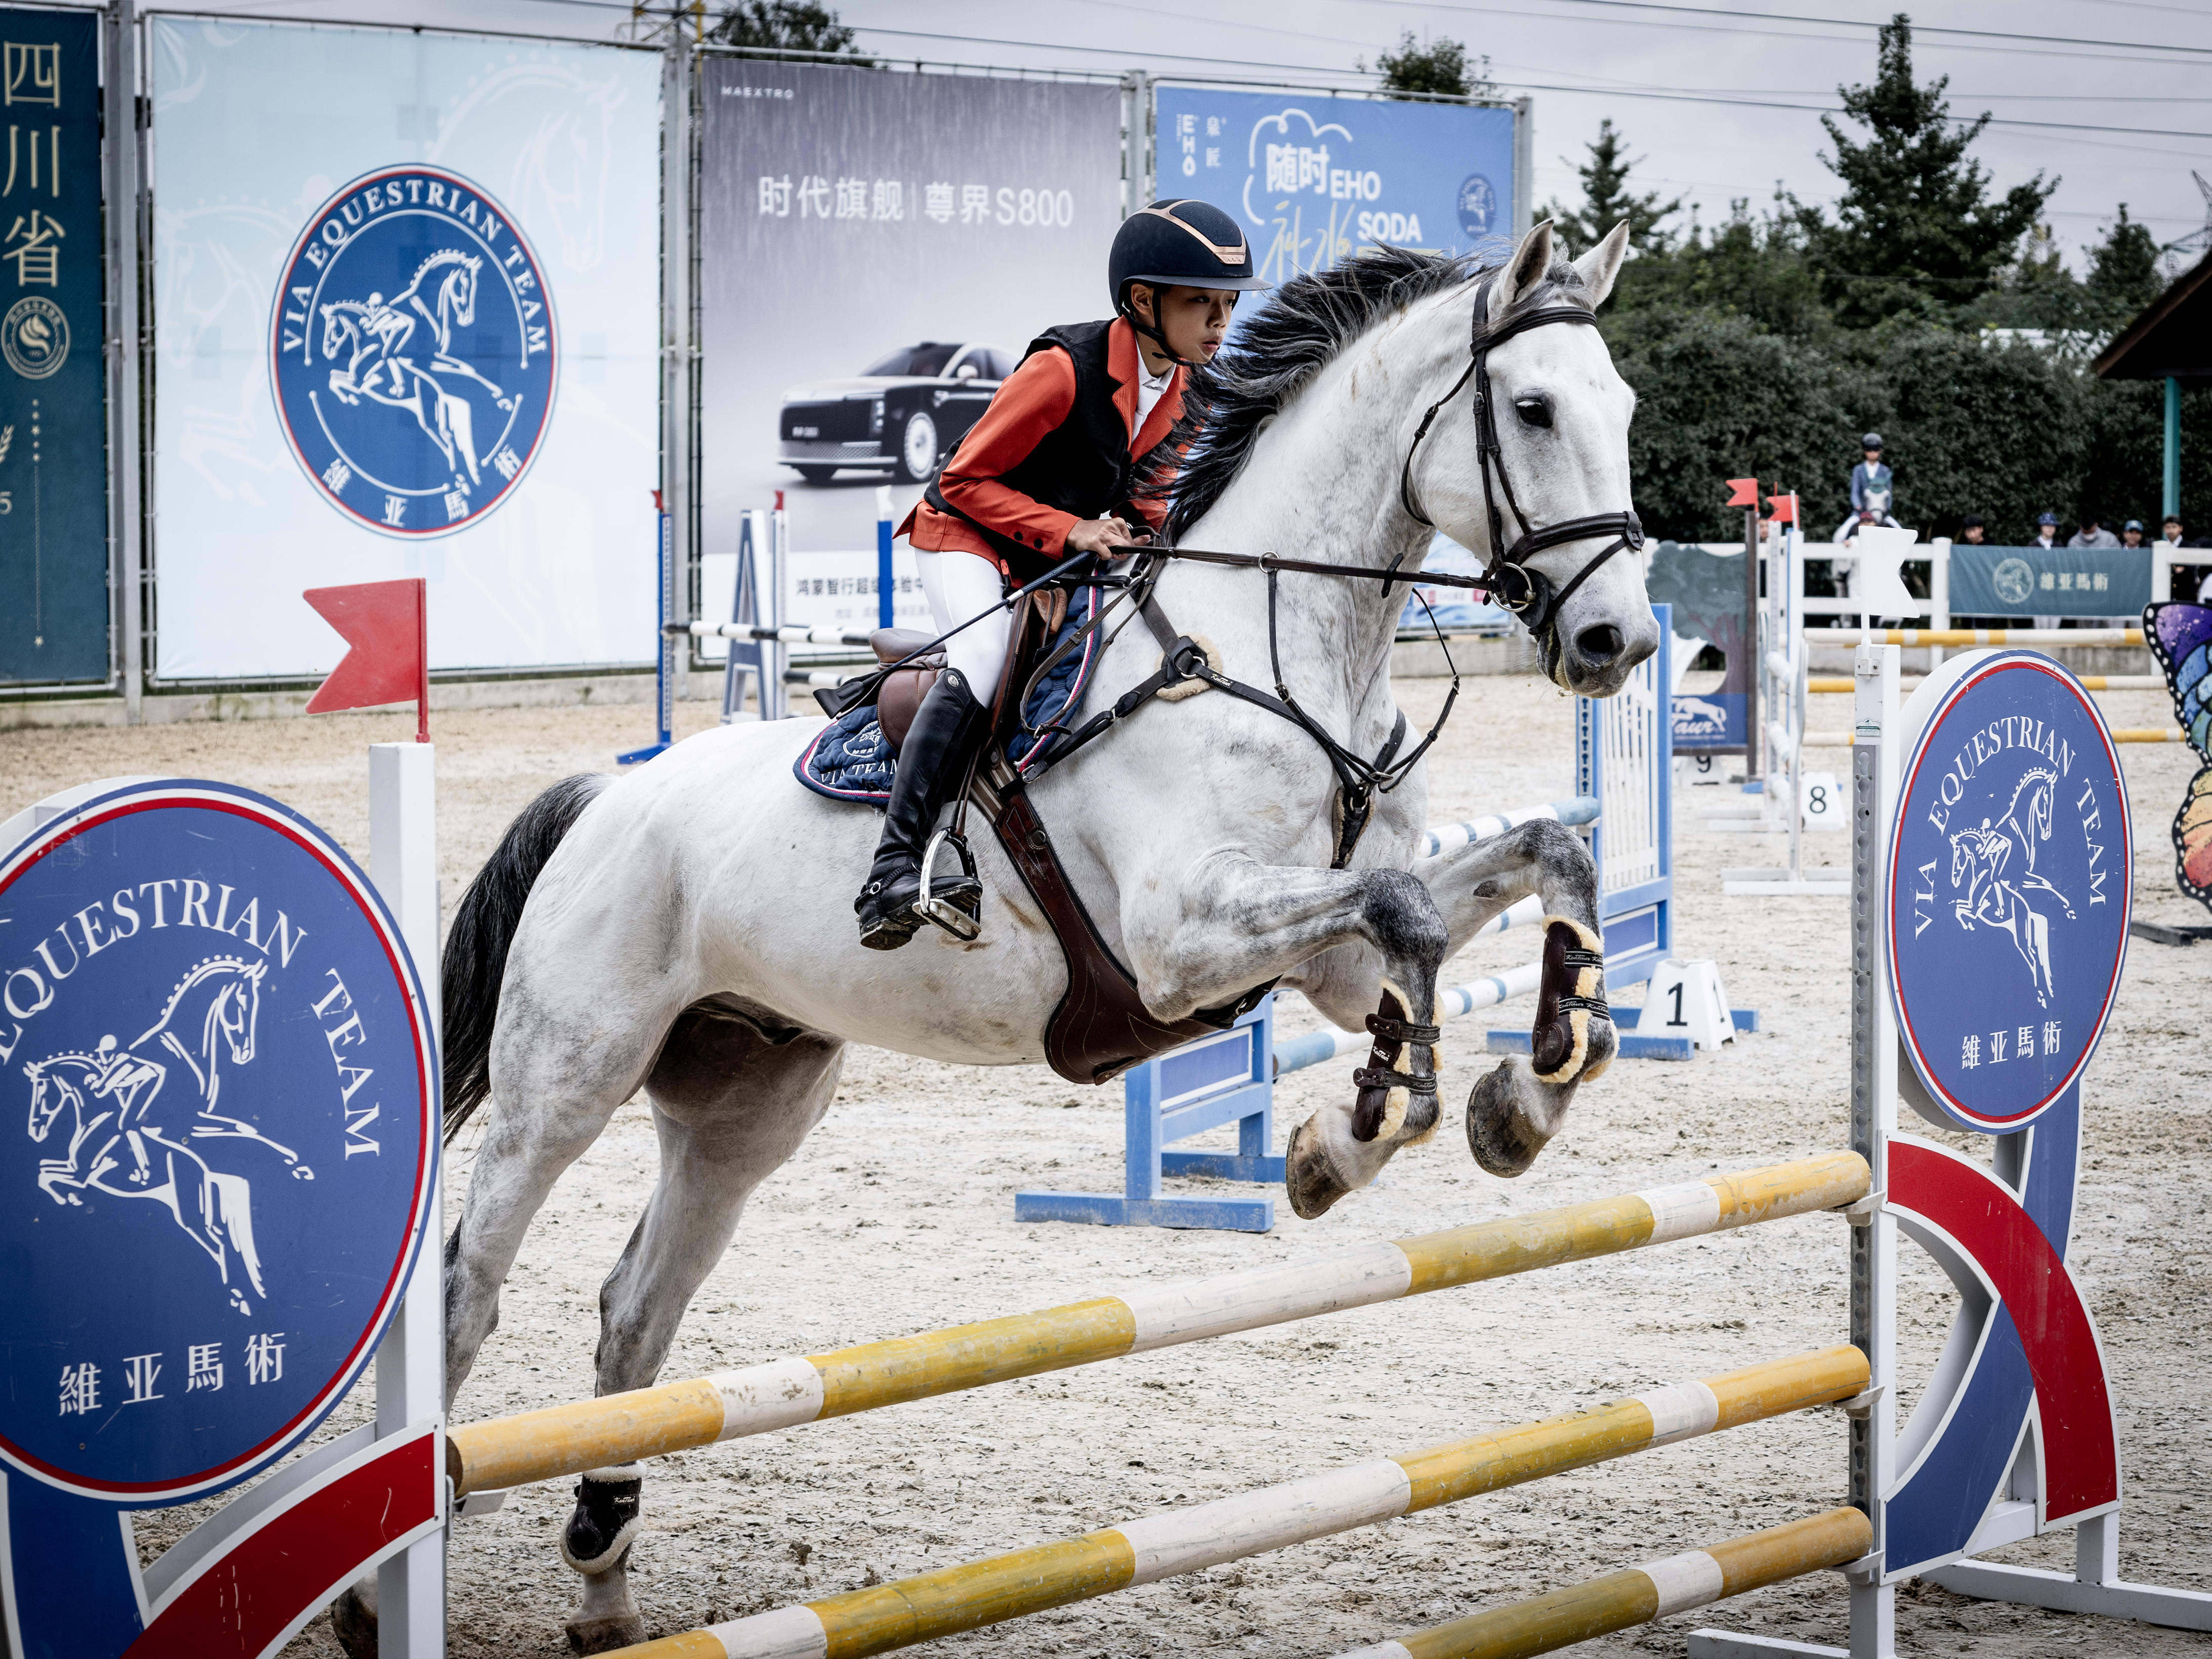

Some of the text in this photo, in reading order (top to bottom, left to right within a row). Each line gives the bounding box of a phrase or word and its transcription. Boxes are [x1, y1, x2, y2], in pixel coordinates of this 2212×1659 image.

[721, 86, 794, 100] MAEXTRO
[3, 40, 66, 287] 四川省
[1266, 143, 1382, 201] 随时 EHO
[759, 175, 1073, 227] 时代旗舰 尊界S800
[1357, 211, 1423, 243] SODA
[283, 178, 548, 354] VIA EQUESTRIAN TEAM
[1810, 786, 1826, 813] 8
[1915, 716, 2107, 940] VIA EQUESTRIAN TEAM
[1666, 982, 1688, 1026] 1
[311, 968, 380, 1159] TEAM
